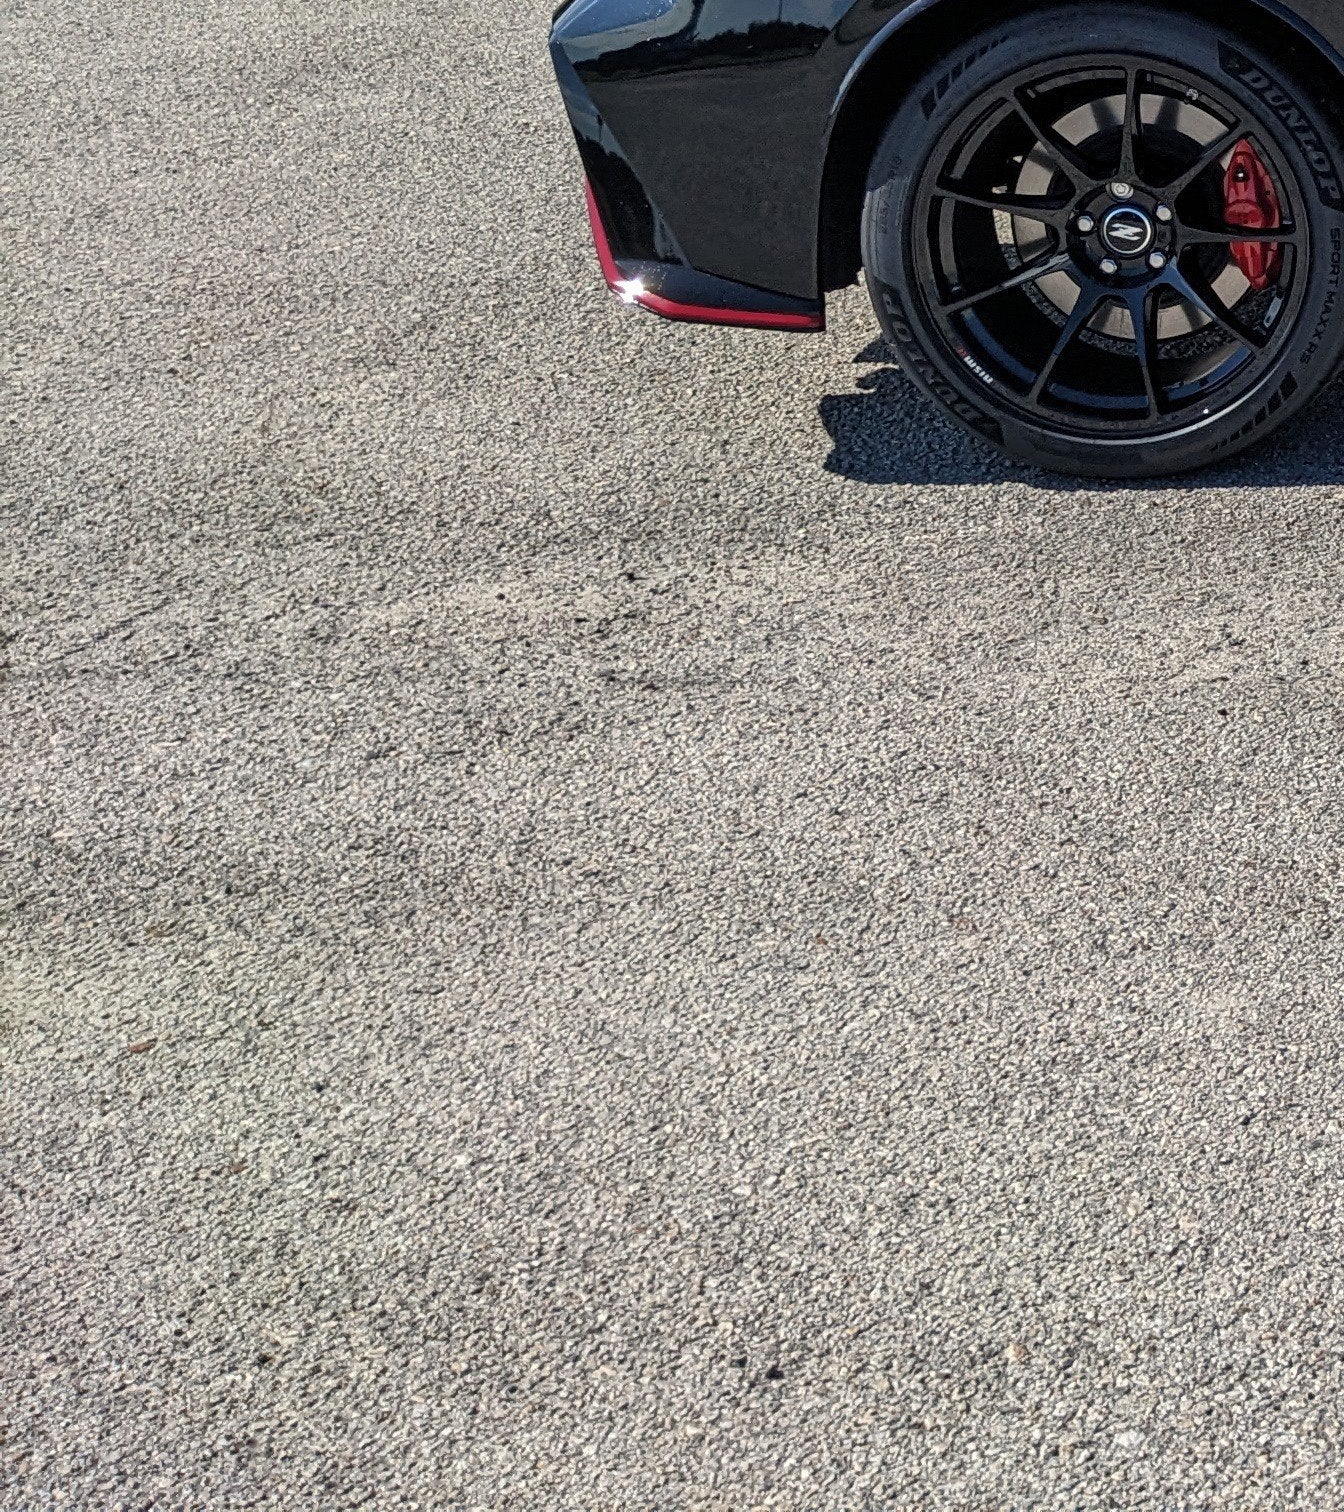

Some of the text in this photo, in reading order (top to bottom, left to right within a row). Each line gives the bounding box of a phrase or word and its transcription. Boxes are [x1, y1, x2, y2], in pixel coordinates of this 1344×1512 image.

[1239, 68, 1342, 199] DUNLOP
[881, 293, 983, 421] DUNLOP
[1300, 227, 1341, 365] SPORT MAXX RS
